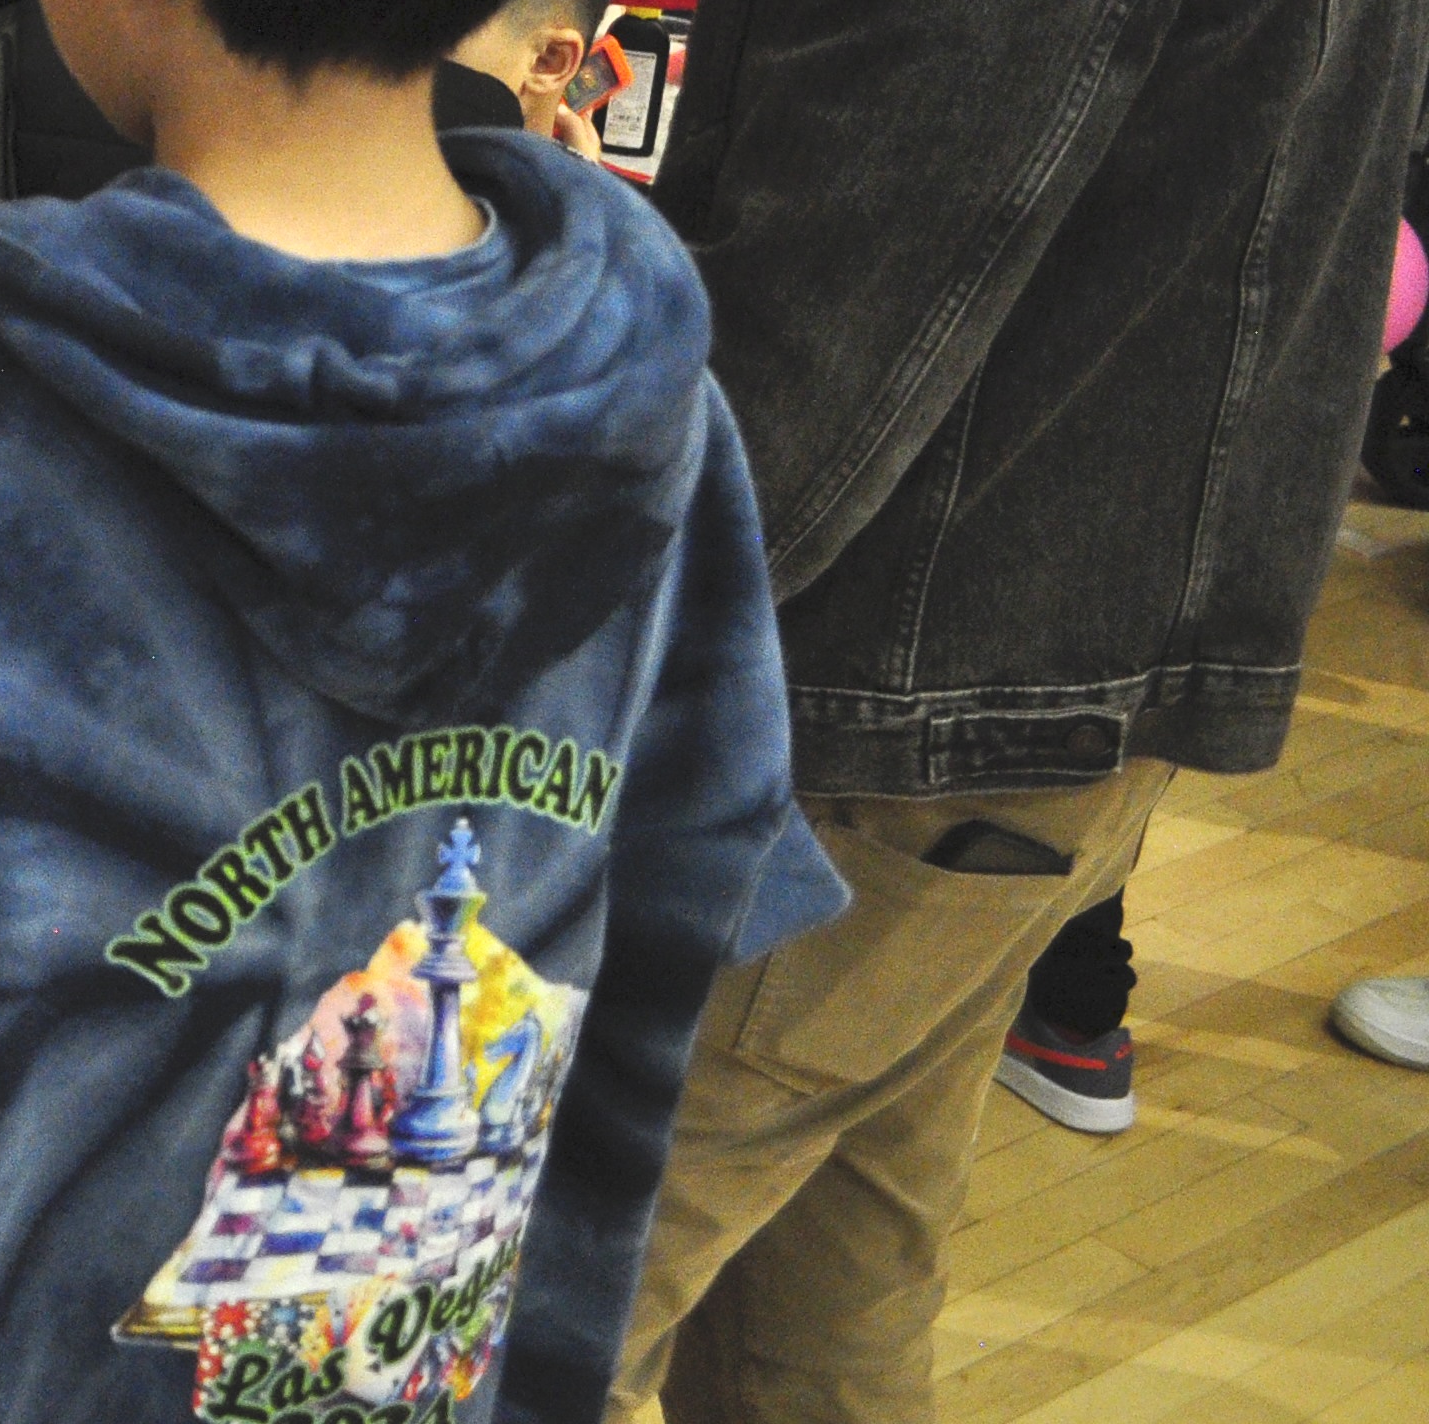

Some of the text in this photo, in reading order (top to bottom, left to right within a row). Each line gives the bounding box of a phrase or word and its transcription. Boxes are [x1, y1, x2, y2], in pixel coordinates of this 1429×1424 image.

[105, 724, 621, 998] NORTH AMERICAN
[203, 1349, 349, 1424] Las
